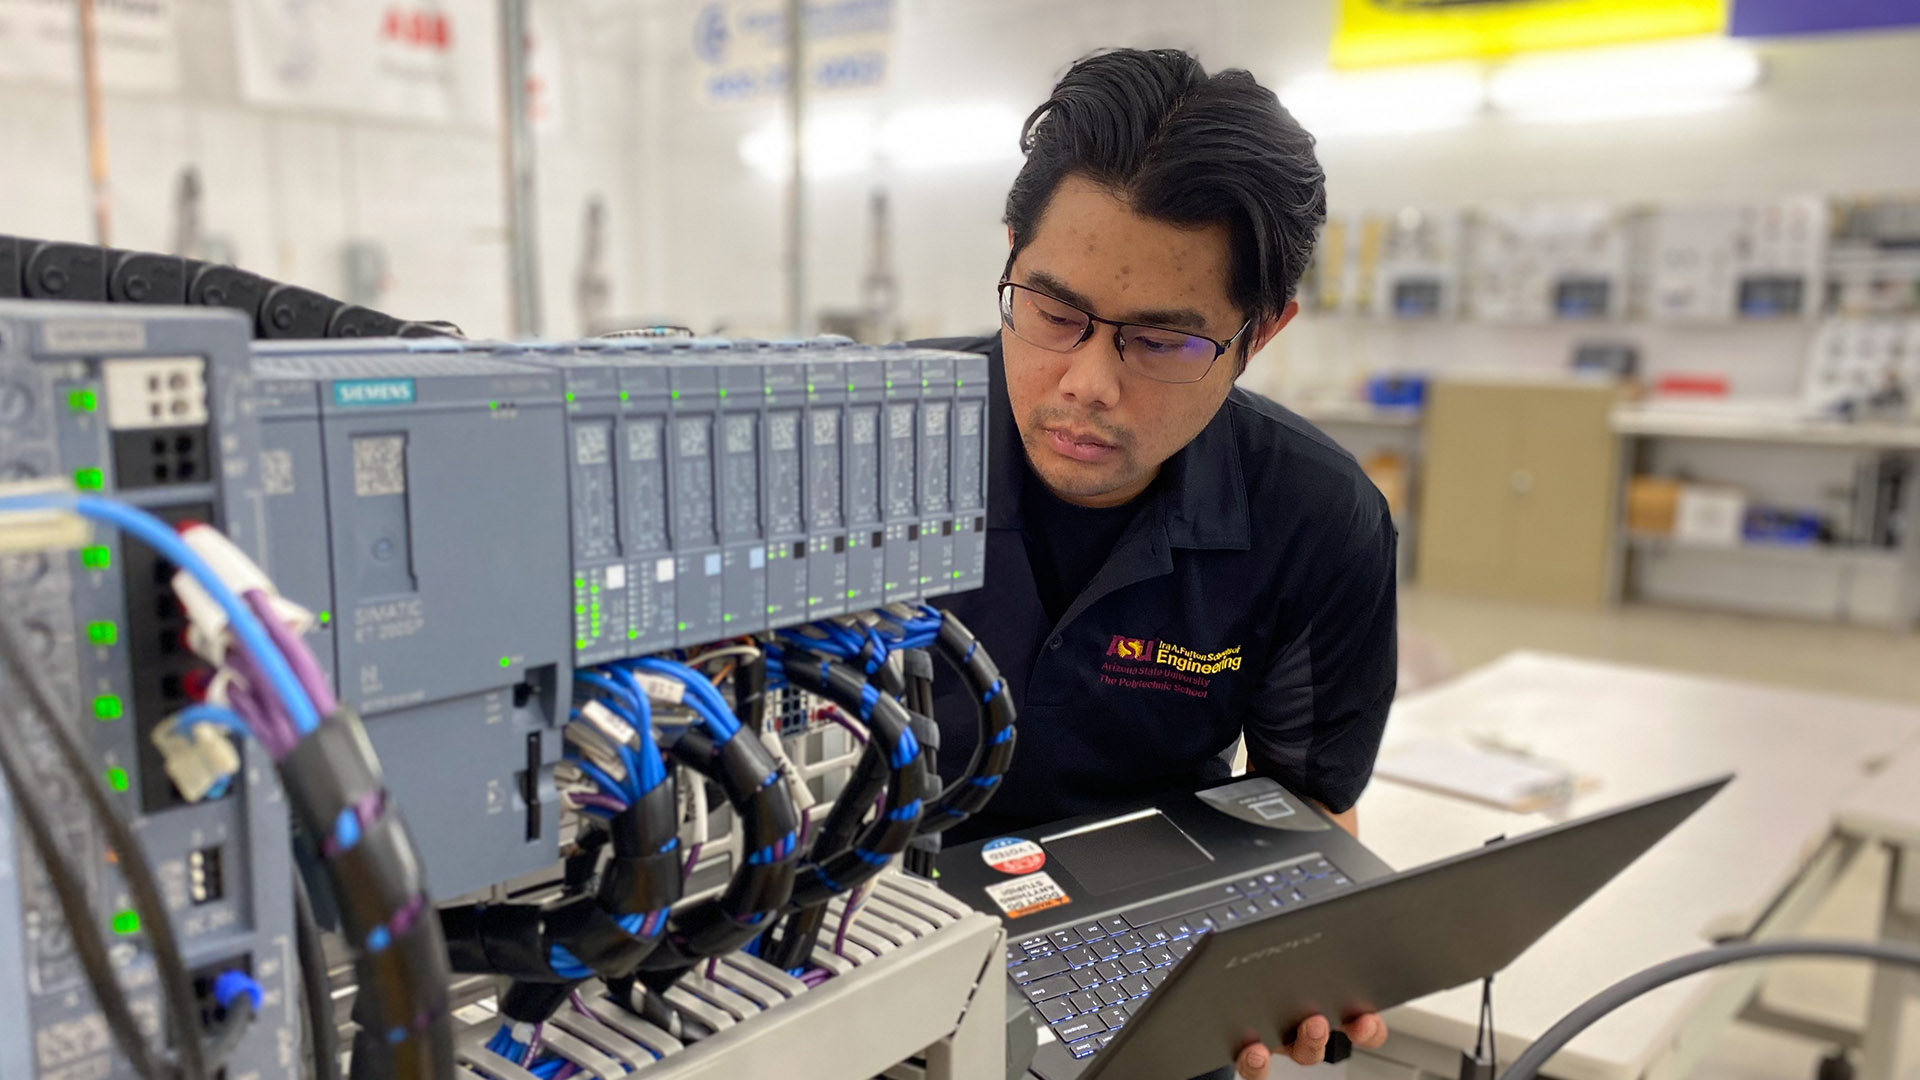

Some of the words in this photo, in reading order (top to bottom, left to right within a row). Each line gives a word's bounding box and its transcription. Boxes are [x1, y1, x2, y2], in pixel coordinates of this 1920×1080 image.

[340, 382, 411, 402] SIEMENS
[1105, 635, 1154, 661] ASU
[1159, 640, 1171, 651] Ira
[1180, 647, 1206, 662] Fulton
[1156, 649, 1242, 675] Engineering
[1100, 674, 1116, 685] The
[1118, 676, 1172, 691] Polytechnic
[1174, 684, 1208, 698] School
[1101, 662, 1138, 675] Arizona
[1138, 666, 1162, 677] State
[1164, 670, 1210, 687] University
